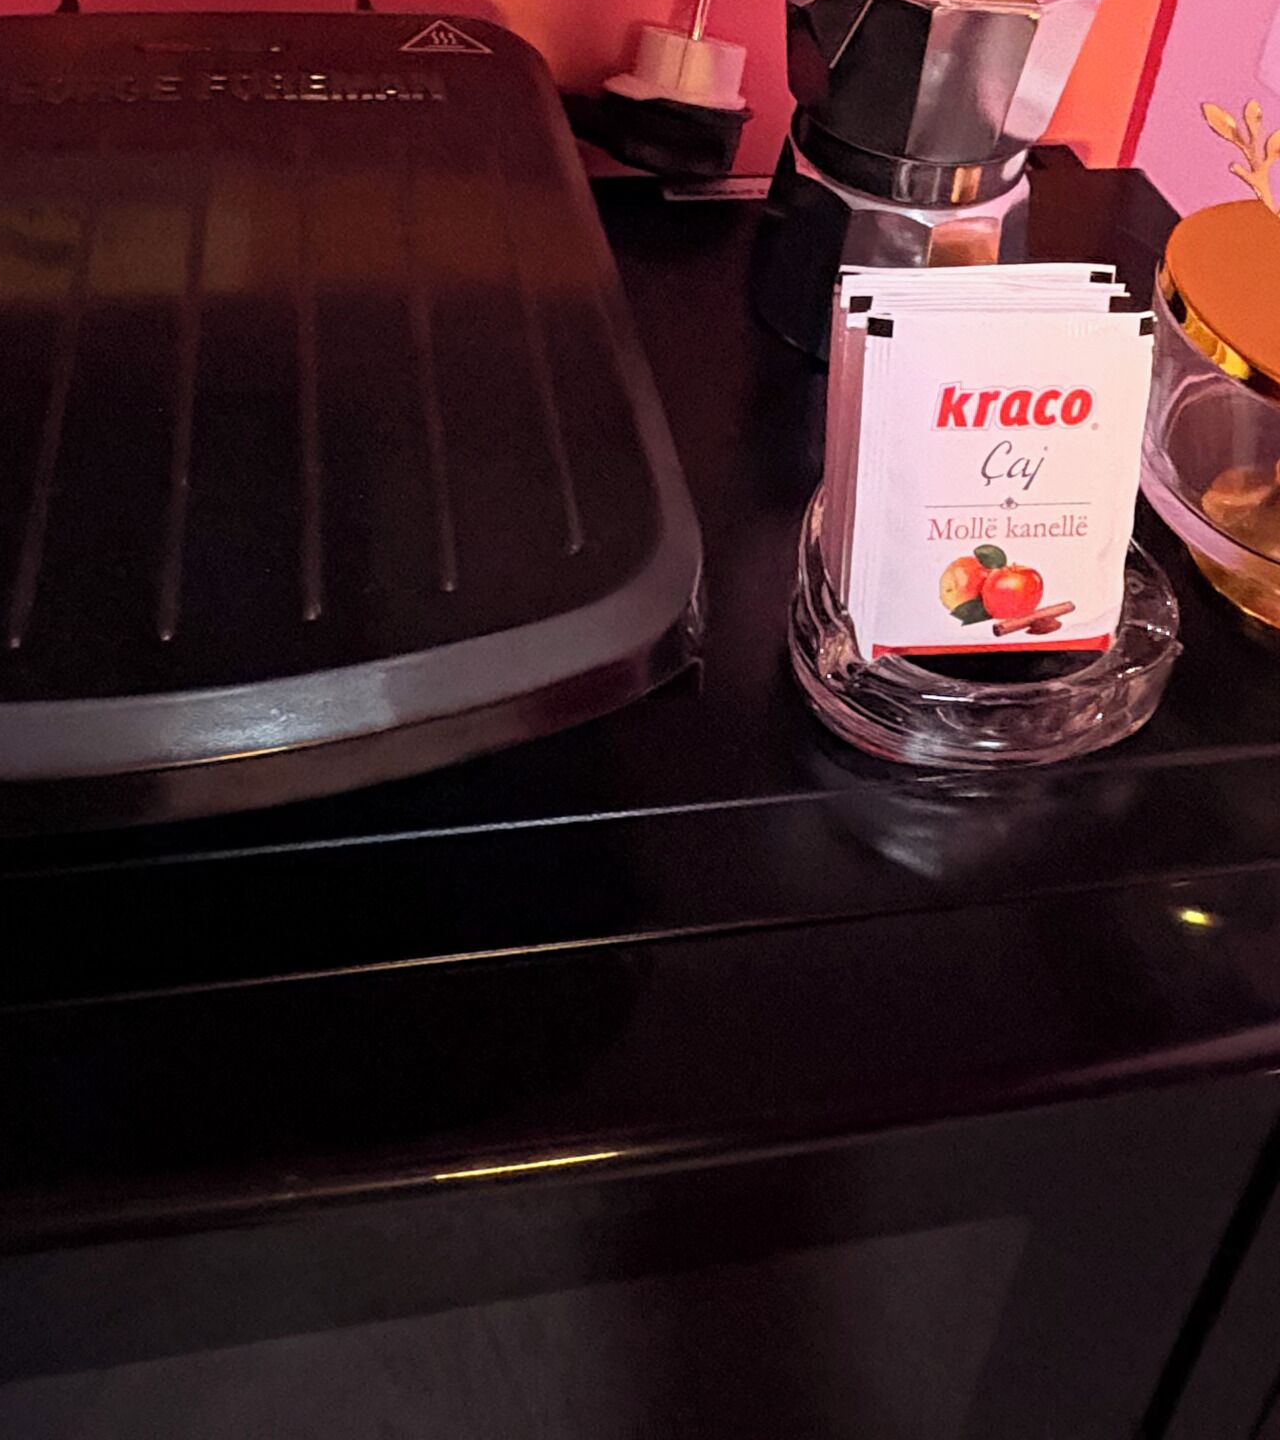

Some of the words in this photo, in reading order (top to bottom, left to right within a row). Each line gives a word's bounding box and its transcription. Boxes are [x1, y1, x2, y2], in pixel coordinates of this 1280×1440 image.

[935, 385, 1094, 429] kraco
[980, 440, 1048, 491] Çaj
[926, 517, 998, 541] Mollë
[1005, 514, 1089, 539] kanellë
